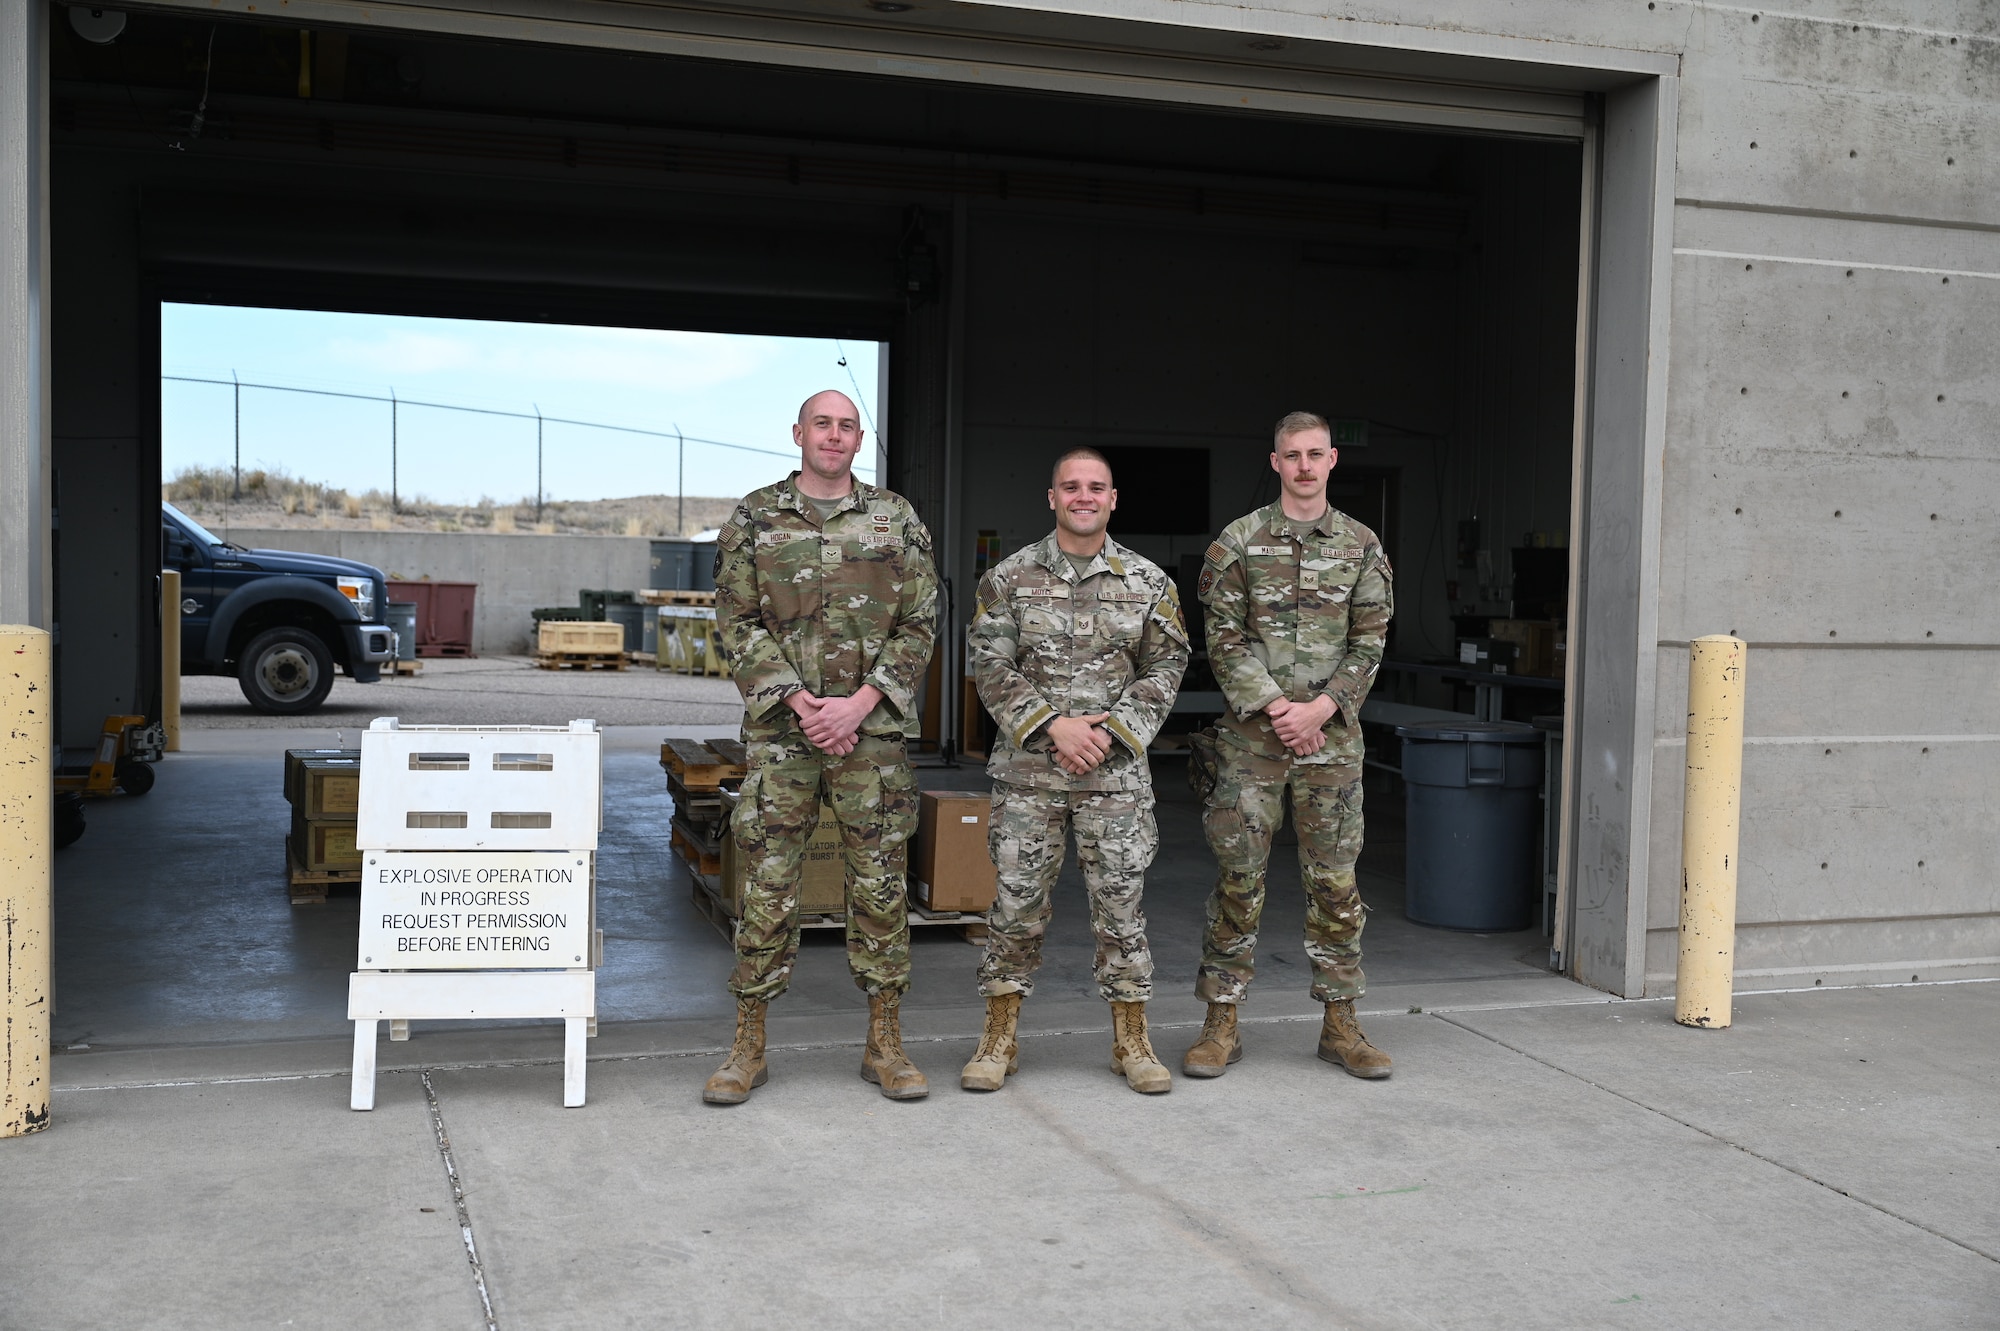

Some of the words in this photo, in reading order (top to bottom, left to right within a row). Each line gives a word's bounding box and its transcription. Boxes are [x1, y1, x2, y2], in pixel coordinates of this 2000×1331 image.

[770, 533, 791, 542] HOGAN
[873, 536, 882, 544] AIR
[883, 537, 901, 545] FORCE
[1343, 550, 1362, 558] FORCE
[1126, 593, 1145, 601] FORCE
[810, 852, 835, 860] BURST
[379, 869, 472, 884] EXPLOSIVE
[476, 868, 573, 883] OPERATION
[421, 891, 436, 906] IN
[440, 891, 530, 906] PROGRESS
[382, 914, 462, 929] REQUEST
[467, 913, 567, 928] PERMISSION
[398, 937, 461, 952] BEFORE
[467, 936, 550, 951] ENTERING
